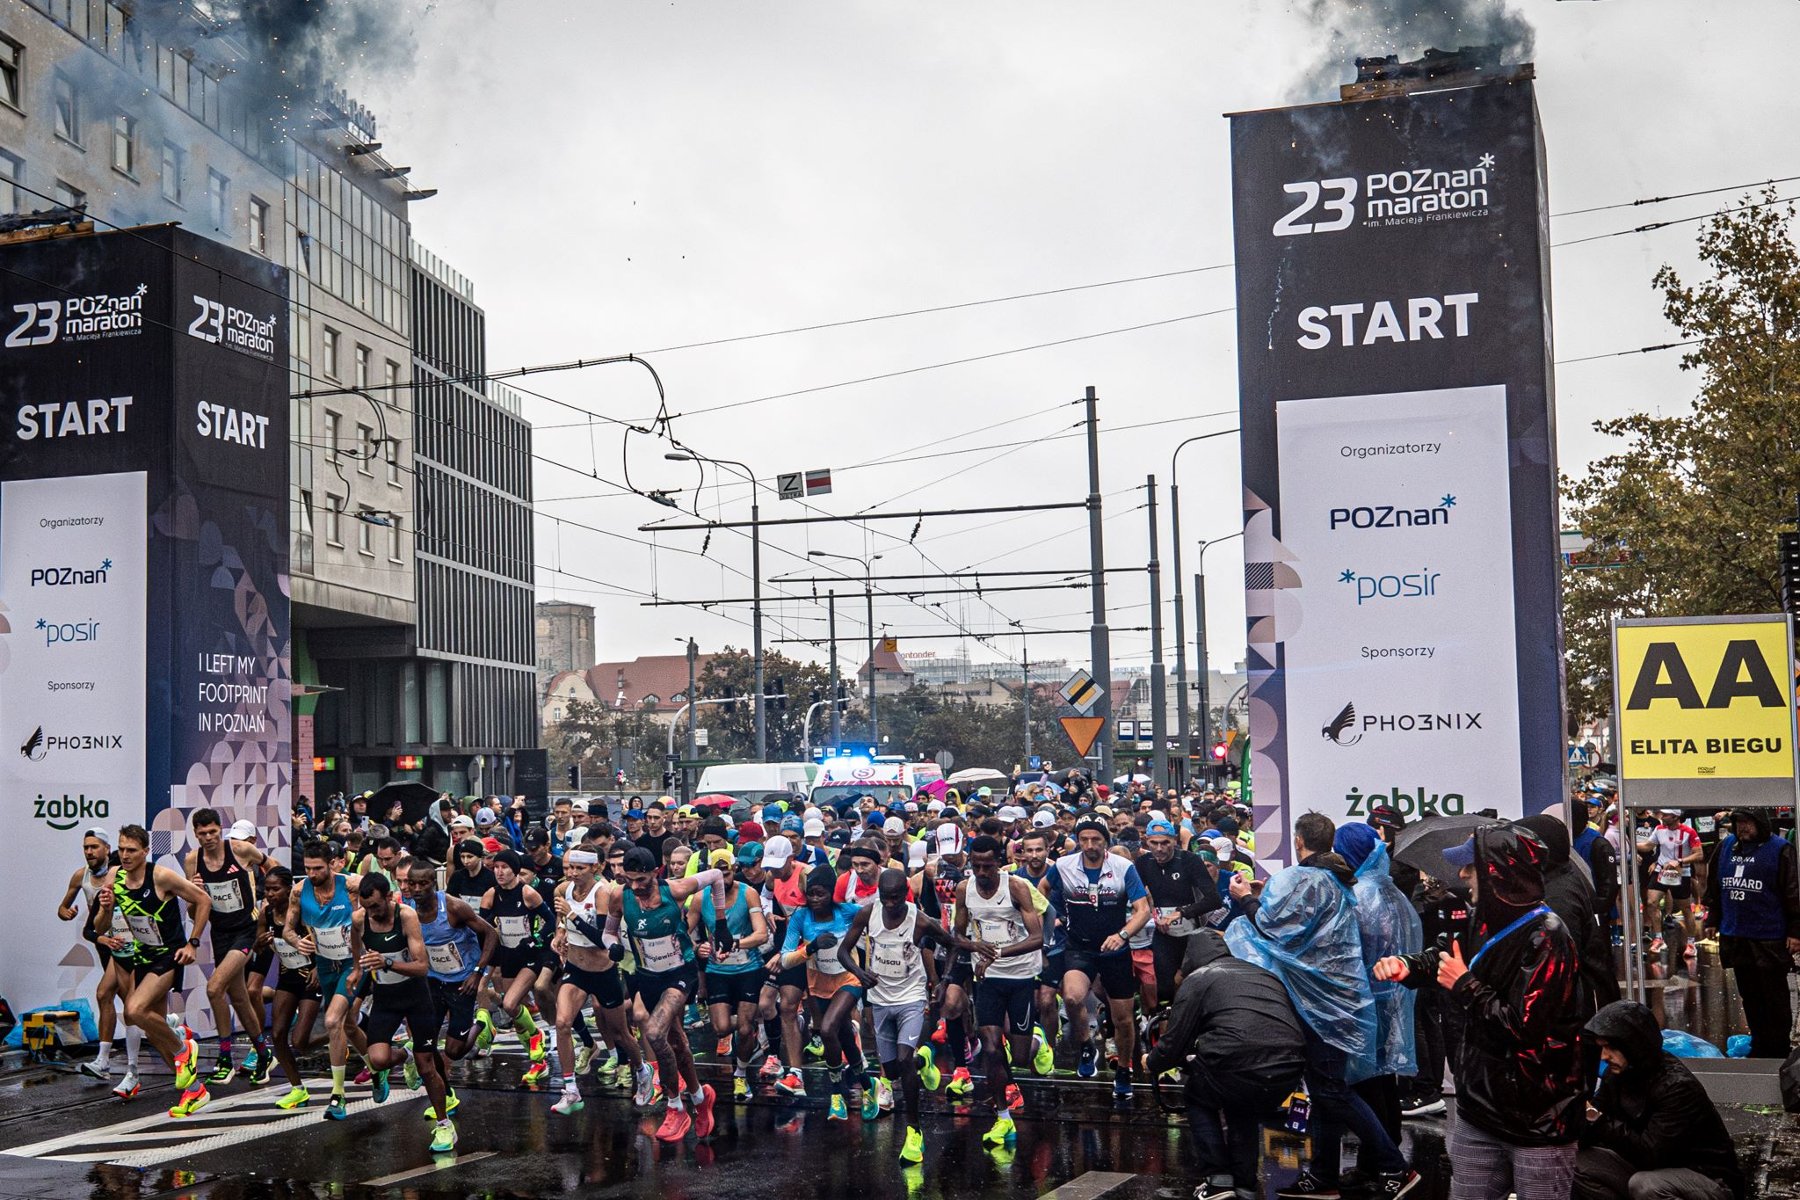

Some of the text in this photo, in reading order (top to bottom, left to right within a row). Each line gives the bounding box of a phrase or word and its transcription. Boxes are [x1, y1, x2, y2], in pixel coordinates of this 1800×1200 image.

[1272, 177, 1359, 237] 23
[1366, 188, 1489, 218] maraton
[1384, 216, 1423, 227] Macieja
[1425, 209, 1489, 221] Frankiewicza
[4, 300, 62, 348] 23
[65, 312, 142, 335] maraton
[187, 295, 226, 346] 23
[1296, 292, 1479, 351] START
[227, 327, 274, 354] maraton
[16, 395, 134, 441] START
[196, 400, 270, 450] START
[1340, 442, 1442, 460] Organizatorzy
[781, 474, 799, 492] Z
[39, 515, 104, 530] Organizatorzy
[1357, 567, 1441, 606] posir
[46, 617, 100, 648] posir
[198, 652, 256, 675] I LEFT MY
[1360, 645, 1436, 661] Sponsorzy
[47, 680, 96, 693] Sponsorzy
[1626, 639, 1786, 711] AA
[198, 682, 268, 704] FOOTPRINT
[198, 709, 265, 733] IN POZNAŃ
[1630, 737, 1782, 755] ELITA BIEGU
[33, 794, 110, 819] żabka
[1345, 786, 1465, 818] żabka
[1722, 877, 1763, 890] STEWARD
[213, 893, 233, 901] PACE
[431, 955, 451, 963] PACE
[875, 954, 901, 966] Musau
